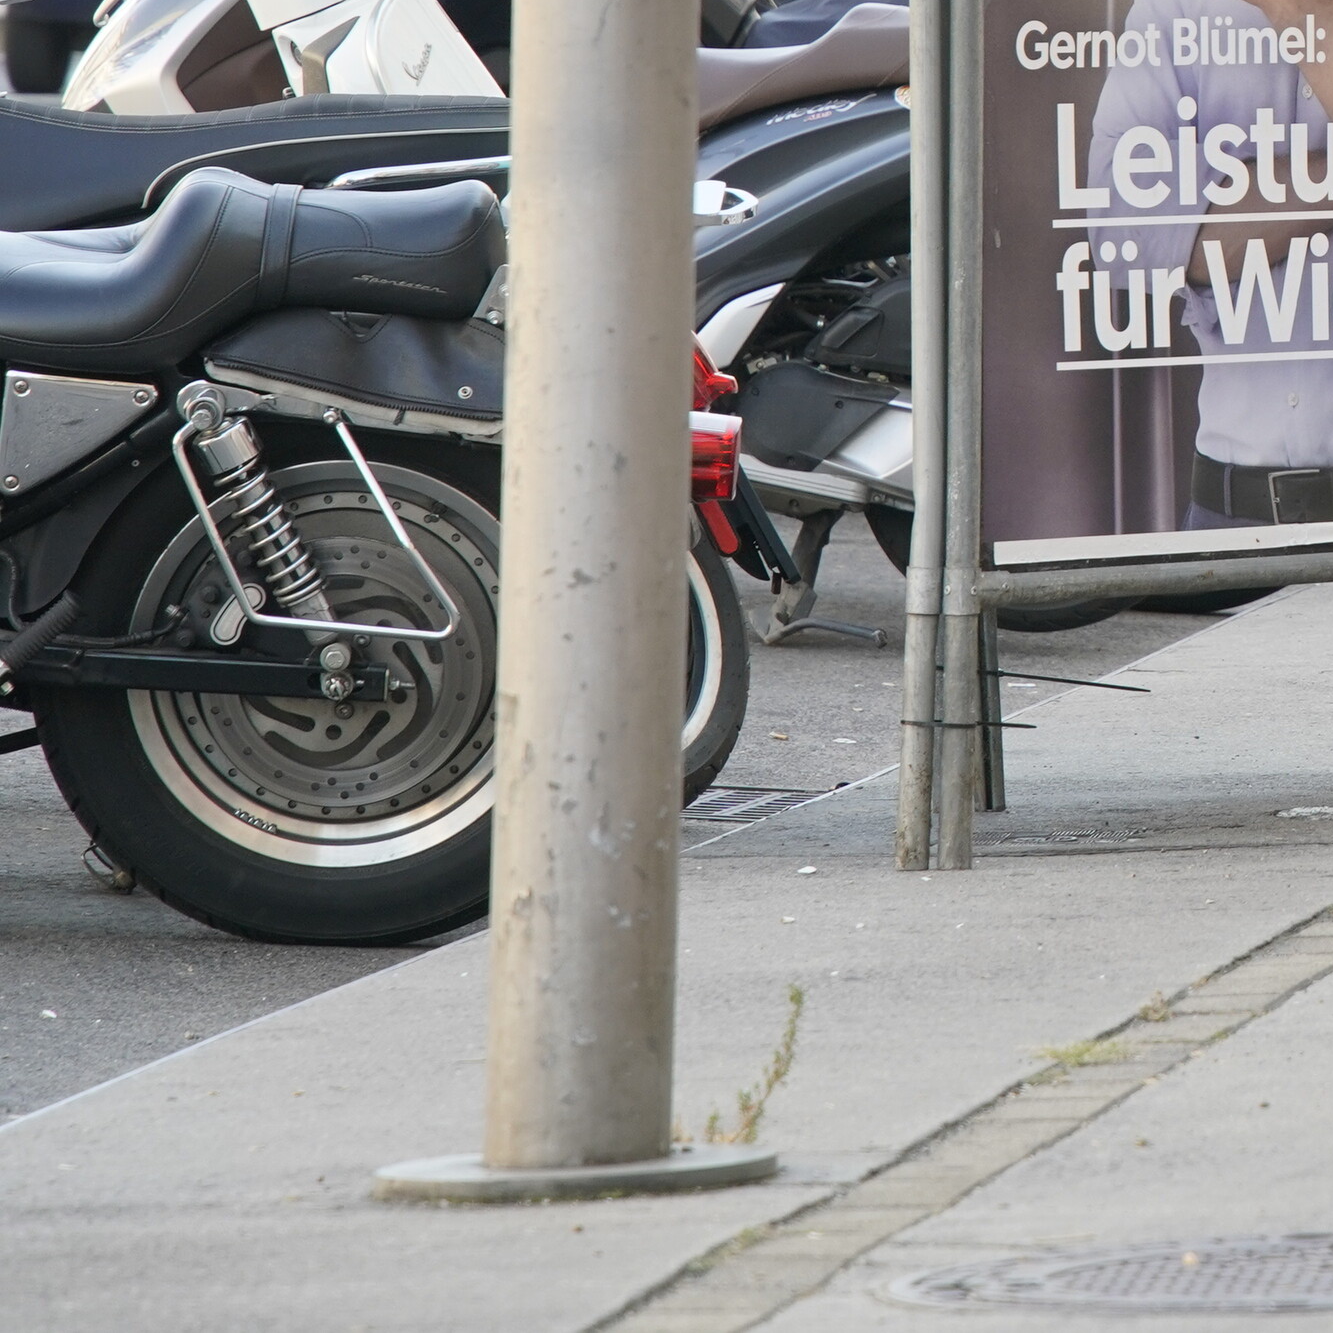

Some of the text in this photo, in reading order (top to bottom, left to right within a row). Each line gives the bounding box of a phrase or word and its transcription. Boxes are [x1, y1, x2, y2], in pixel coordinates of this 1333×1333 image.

[1015, 14, 1327, 70] Gernot Blümel:
[1056, 240, 1185, 352] für
